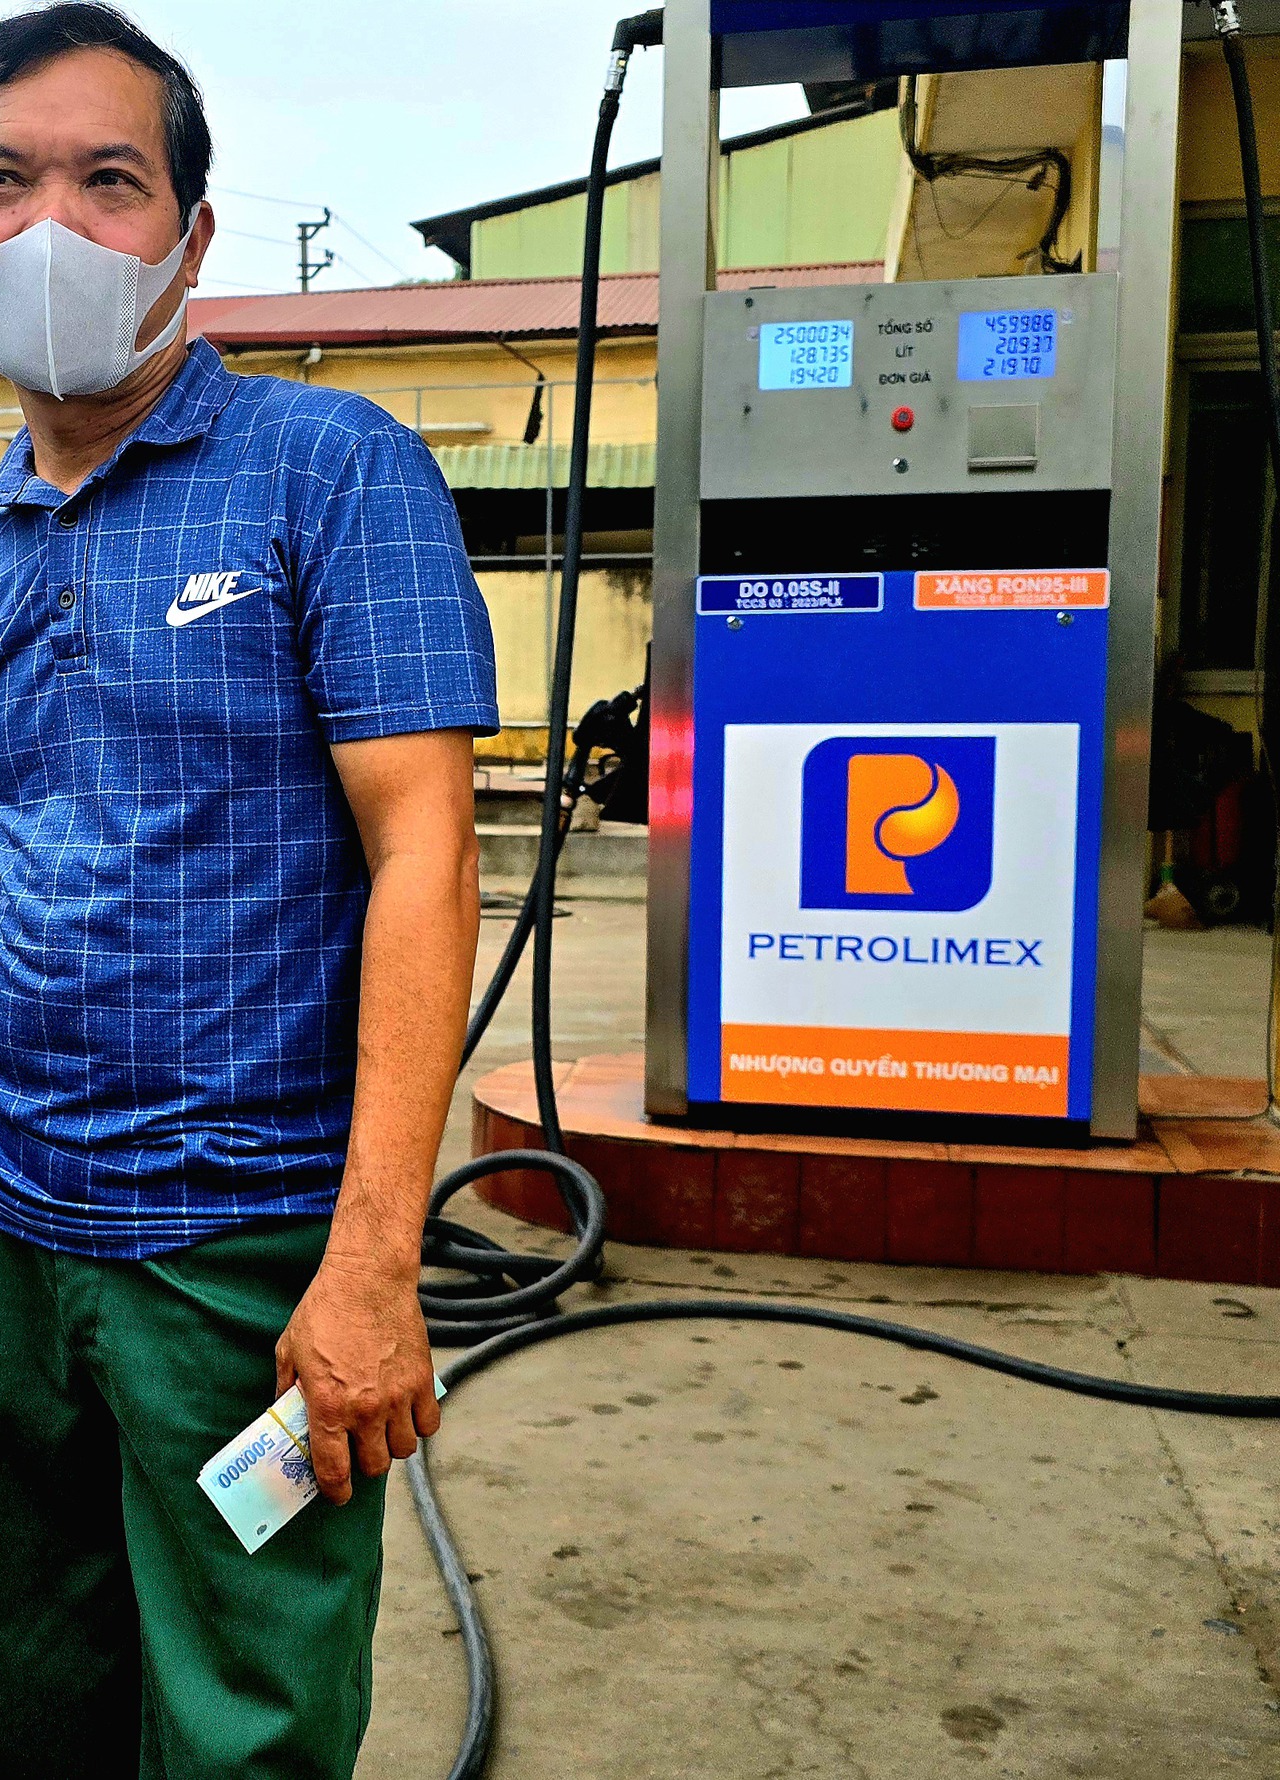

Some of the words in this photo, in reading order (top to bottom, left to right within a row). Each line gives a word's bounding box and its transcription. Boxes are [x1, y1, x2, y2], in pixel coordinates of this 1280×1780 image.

[878, 318, 912, 335] TỔNG
[915, 317, 933, 333] SỐ
[985, 314, 1053, 334] 459986
[774, 325, 850, 344] 2500034
[790, 366, 839, 384] 19420
[983, 356, 1041, 376] 21970
[179, 571, 241, 603] NIKE
[739, 582, 769, 598] DO
[748, 932, 1043, 967] PETROLIMEX
[730, 1053, 824, 1078] NHƯỢNG
[830, 1053, 908, 1078] QUYỀN
[1014, 1065, 1060, 1090] MẠI
